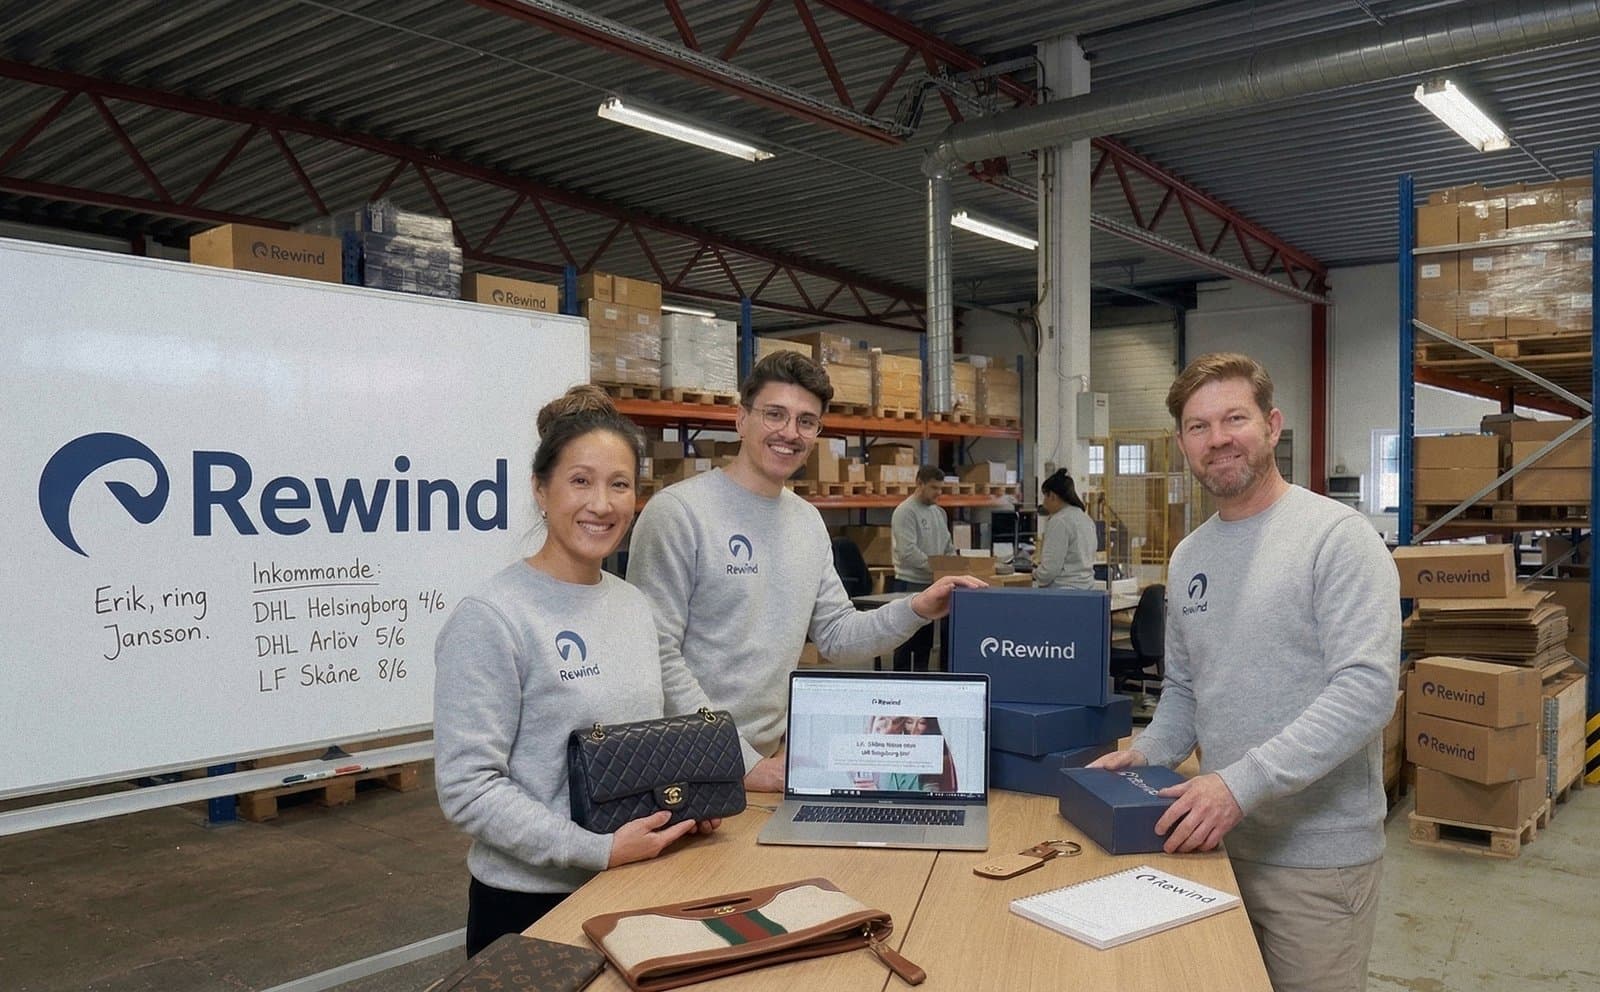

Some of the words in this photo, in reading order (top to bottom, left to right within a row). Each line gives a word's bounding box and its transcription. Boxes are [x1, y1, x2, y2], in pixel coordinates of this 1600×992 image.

[271, 244, 325, 265] Rewind
[506, 291, 546, 309] Rewind
[193, 450, 508, 535] Rewind
[253, 557, 382, 584] Inkommande:
[726, 563, 758, 575] Rewind
[1436, 569, 1490, 584] Rewind
[94, 584, 155, 615] Erik,
[162, 587, 207, 621] ring
[252, 599, 297, 624] DHL
[307, 594, 408, 626] Helsingborg
[418, 589, 446, 614] 4/6
[103, 624, 210, 661] Jansson.
[254, 634, 299, 658] DHL
[309, 630, 359, 653] Arlöv
[375, 625, 406, 649] 5/6
[1001, 639, 1075, 659] Rewind
[259, 667, 287, 693] LF
[300, 663, 361, 687] Skåne
[377, 657, 407, 682] 8/6
[560, 664, 600, 681] Rewind
[1437, 686, 1485, 706] Rewind
[1430, 739, 1475, 761] Rewind
[1152, 880, 1217, 904] Rewind
